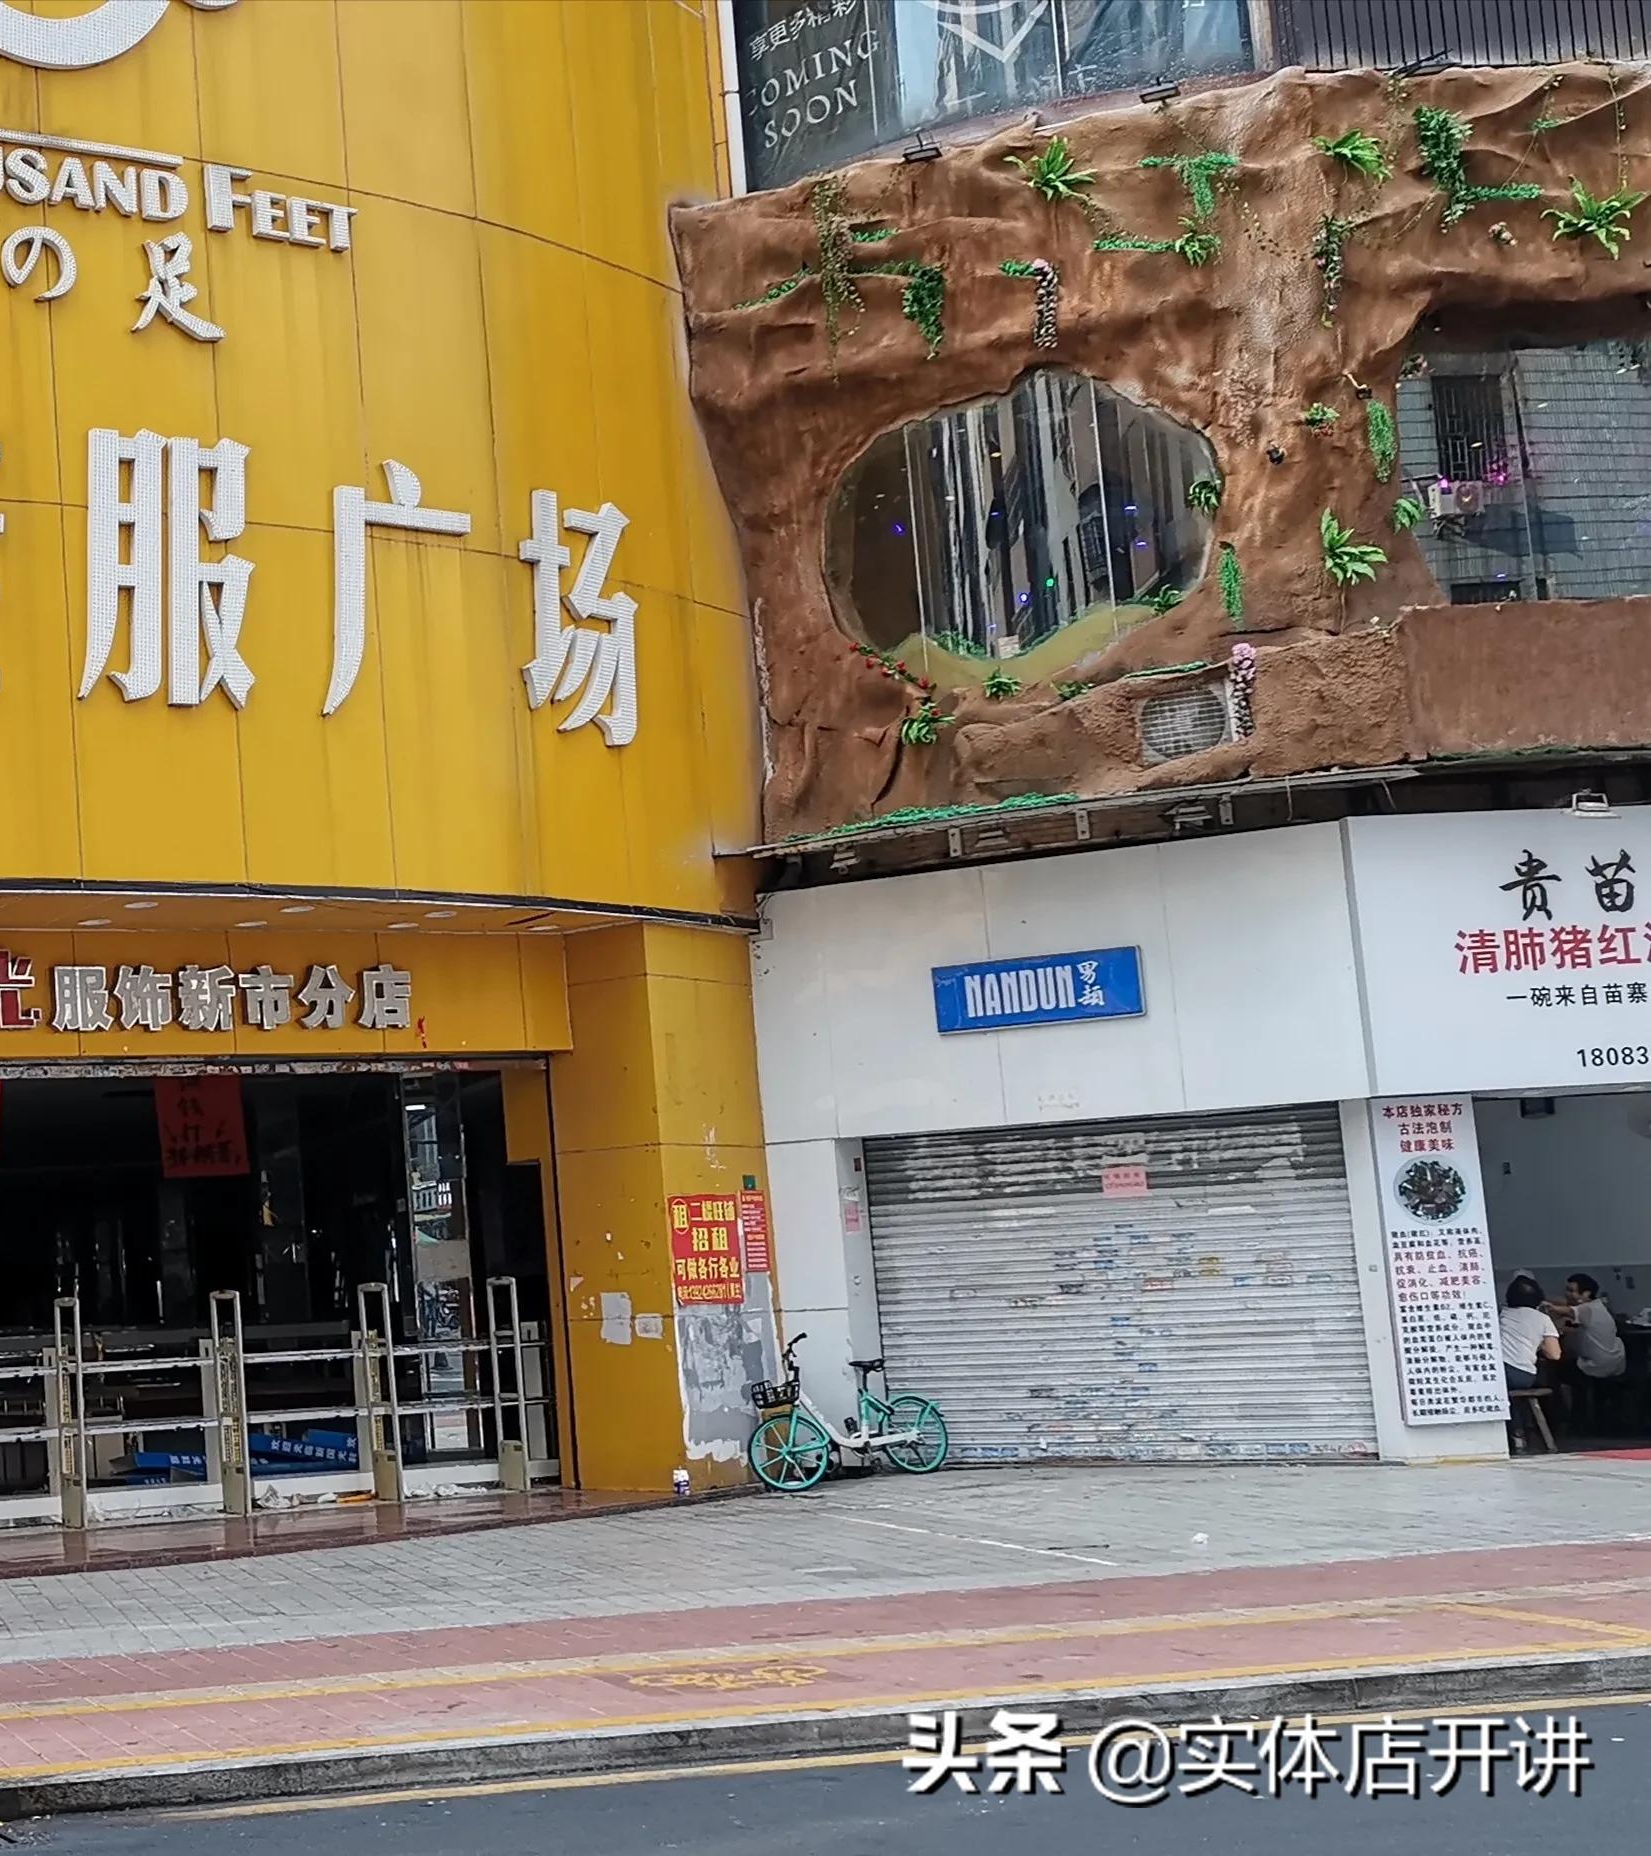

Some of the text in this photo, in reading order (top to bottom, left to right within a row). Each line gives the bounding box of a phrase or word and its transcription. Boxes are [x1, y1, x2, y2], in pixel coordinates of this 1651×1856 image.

[765, 80, 857, 148] SOON
[1499, 849, 1636, 921] 贵苗
[1454, 921, 1651, 974] 清肺猪红
[964, 965, 1076, 1018] NANDUN
[1506, 982, 1648, 1008] 一碗来自苗寨
[1577, 1046, 1651, 1068] 18083
[1382, 1103, 1463, 1118] 本店独家秘方
[1400, 1138, 1454, 1152] 健康美味
[692, 1227, 729, 1252] 招租
[675, 1256, 739, 1280] 可做各行各业
